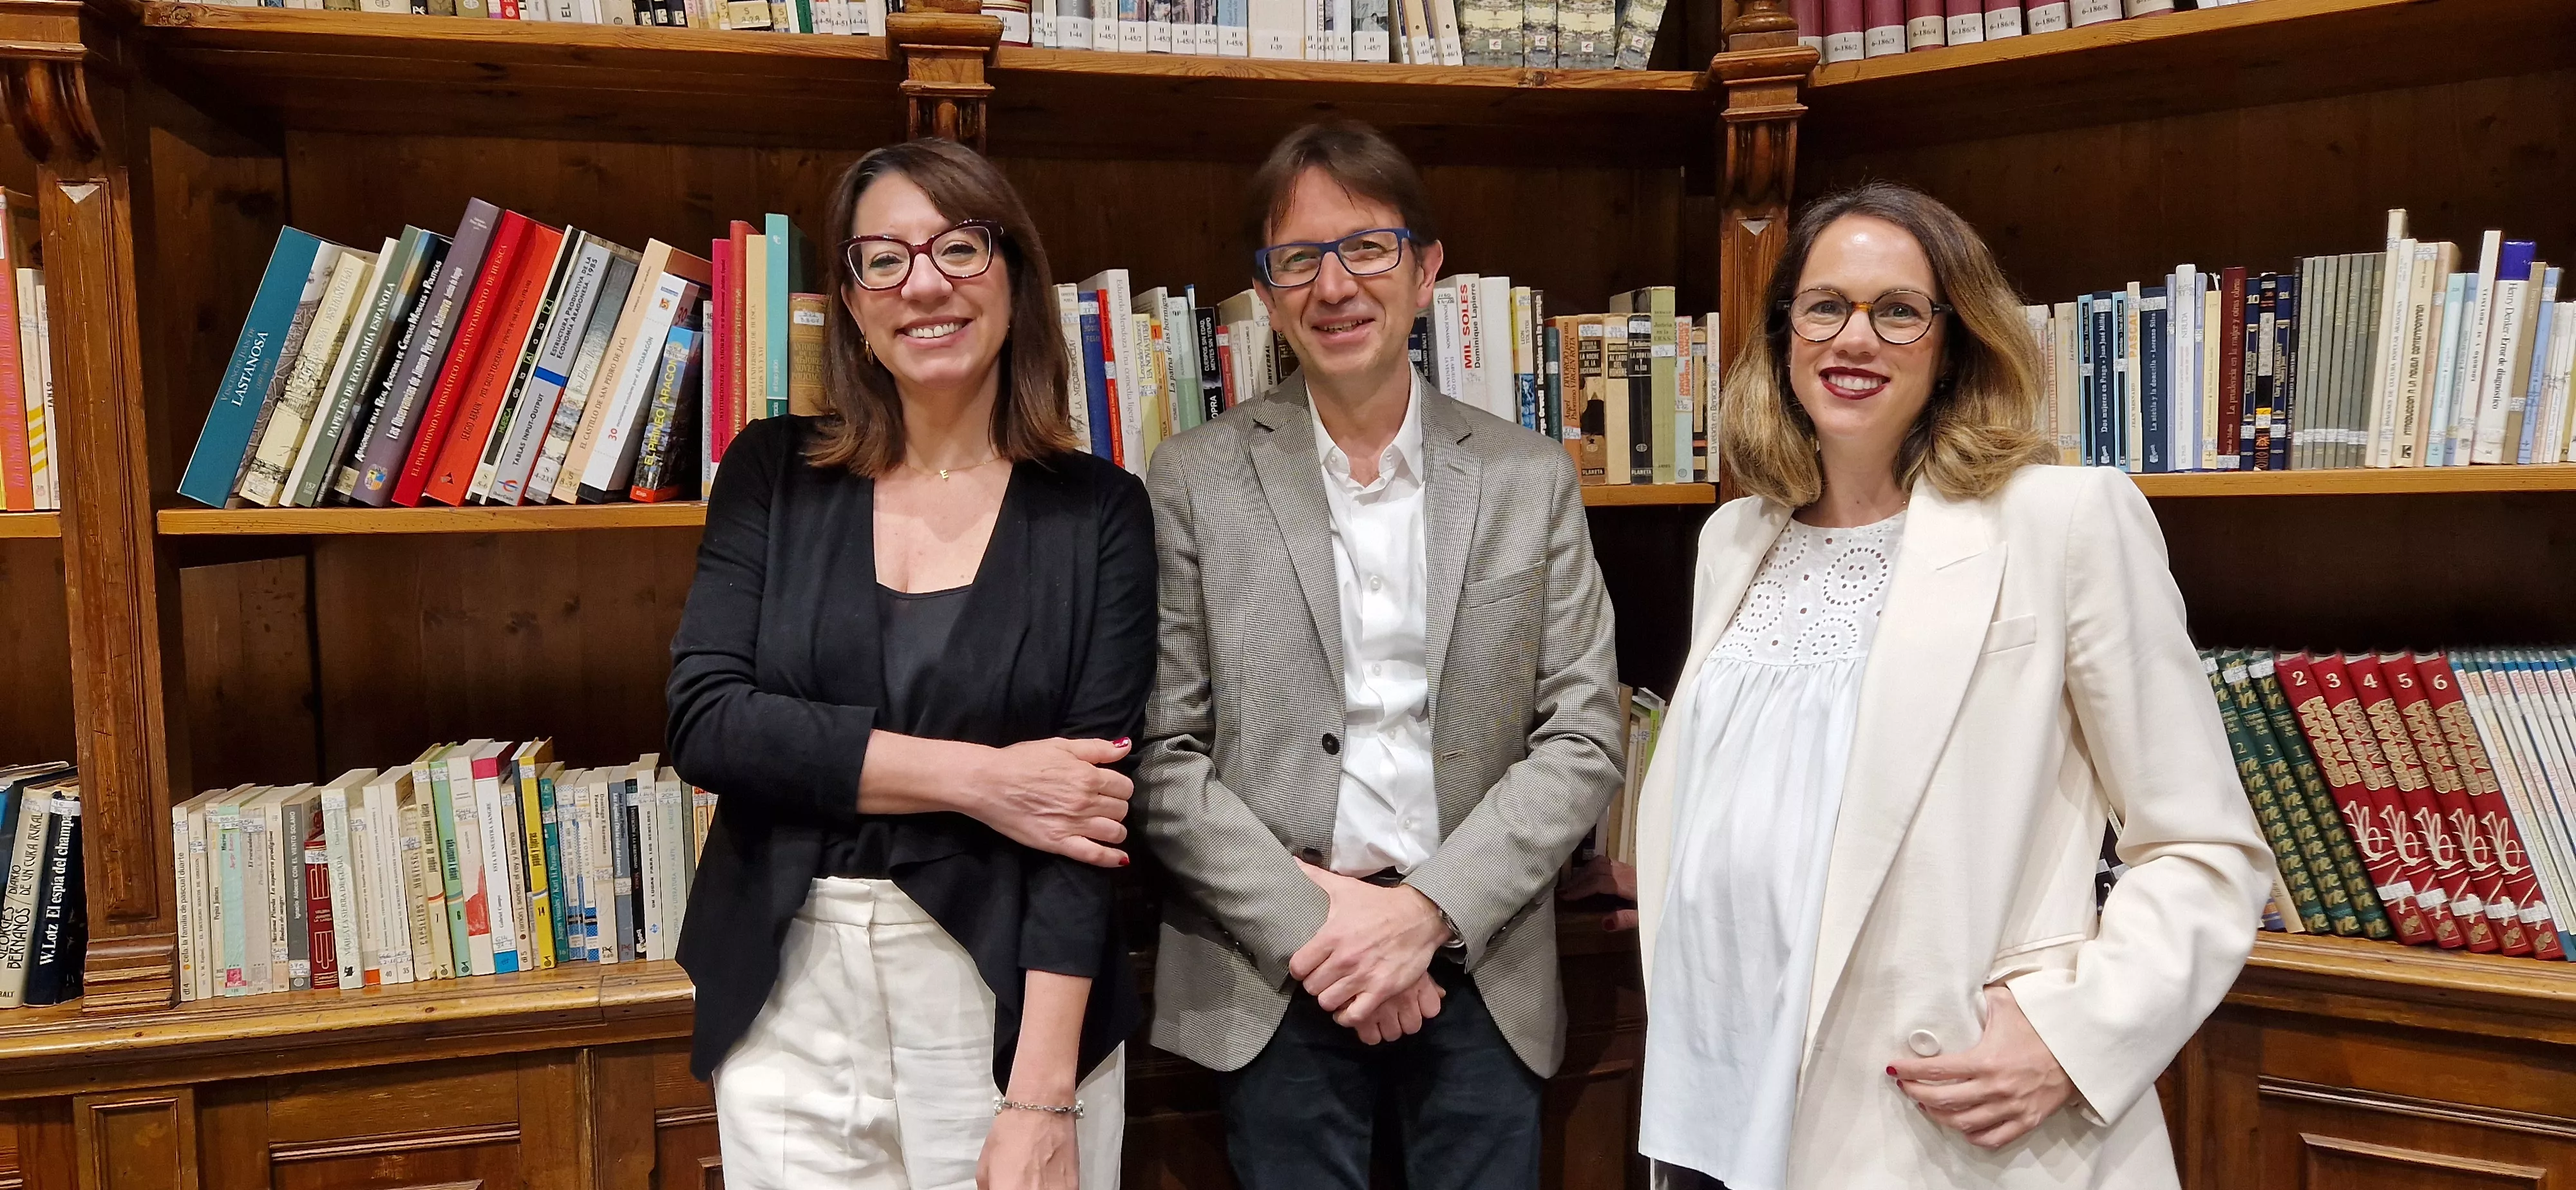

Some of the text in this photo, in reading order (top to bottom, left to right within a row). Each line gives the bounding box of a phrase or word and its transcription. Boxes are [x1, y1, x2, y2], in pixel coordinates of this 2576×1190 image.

[561, 3, 571, 17] EL
[1913, 29, 1937, 37] 6-186/4
[1989, 20, 2015, 30] 6-186/6
[2231, 278, 2240, 298] obras
[549, 254, 592, 357] ESTRUCTURA PRODUCTIVA DE LA
[555, 321, 574, 360] ECONOMÍA
[586, 257, 598, 277] 1985
[2231, 299, 2239, 317] otras
[1460, 284, 1472, 368] MIL SOLES
[1469, 283, 1481, 368] Dominique Lapierre
[2128, 311, 2137, 358] PASCAL
[2230, 324, 2239, 345] mujer
[1158, 292, 1177, 393] La patria de las hormigas
[2099, 332, 2107, 344] José
[2491, 282, 2517, 410] Henry Denker Error de diagnóstico
[327, 280, 395, 438] PAPELES DE ECONOMÍA ESPAÑOLA
[411, 243, 507, 477] EL PATRIMONIO NUMISMÁTICO DEL AYUNTAMIENTO DE HUESCA
[1115, 278, 1135, 423] Eduardo Mendoza Una comedia ligera
[2099, 345, 2107, 358] Juan
[2230, 356, 2237, 366] en
[230, 330, 270, 406] LASTANOSA
[386, 297, 452, 440] Las Observancias de Jimeno Pérez de Salanova
[497, 406, 513, 434] HUESCA
[509, 387, 520, 399] de
[516, 370, 526, 380] la
[535, 321, 545, 330] la
[2099, 364, 2108, 382] Praga
[578, 335, 630, 449] EL CASTILLO DE SAN PEDRO DE JACA
[606, 335, 654, 442] 30 ALTOARAGÓN
[2227, 368, 2238, 402] prudencia
[2100, 393, 2109, 417] mujeres
[2226, 404, 2236, 415] La
[511, 392, 546, 466] TABLAS INPUT-OUTPUT
[647, 408, 665, 451] PIRINEO
[2100, 419, 2108, 431] Dos
[643, 449, 656, 467] EL
[2292, 670, 2307, 686] 2
[2326, 674, 2342, 688] 3
[2363, 674, 2378, 689] 4
[2398, 673, 2413, 688] 5
[2433, 675, 2448, 690] 6
[2339, 762, 2360, 786] DE
[486, 802, 494, 824] SANGRE
[421, 820, 433, 845] educación
[18, 811, 43, 896] DE UN CURA RURAL
[50, 856, 68, 874] del
[176, 851, 185, 875] duarte
[425, 856, 437, 873] juegos
[7, 864, 21, 894] DIARIO
[48, 874, 68, 904] espía
[178, 876, 189, 903] pascual
[513, 881, 523, 905] sender:
[45, 904, 61, 919] El
[179, 903, 187, 913] de
[179, 914, 189, 938] familia
[516, 911, 525, 931] ramón
[6, 908, 30, 969] BERNANOS
